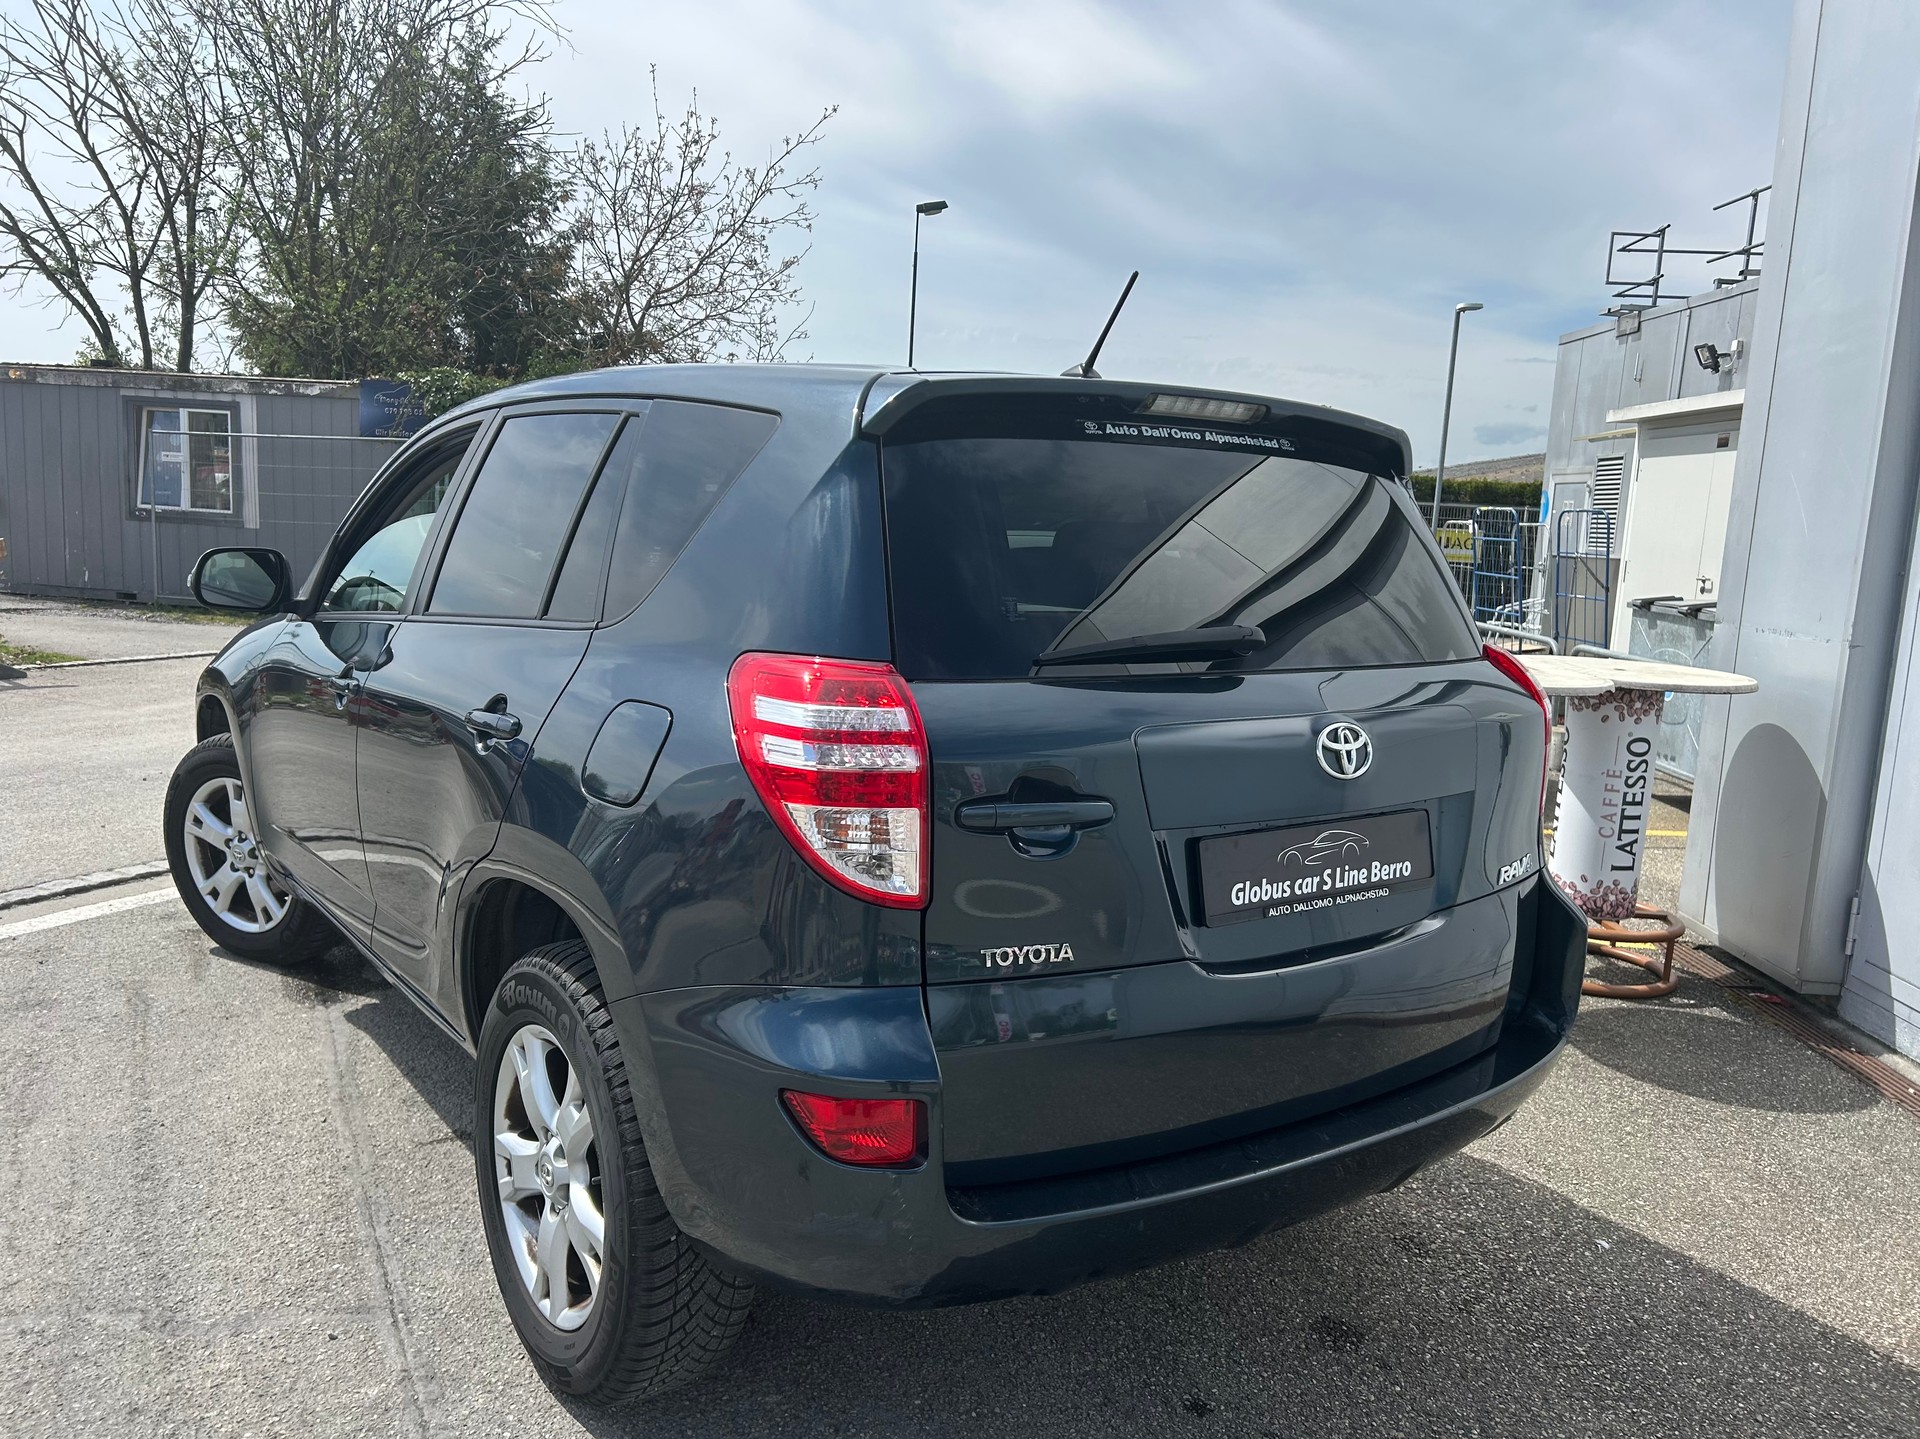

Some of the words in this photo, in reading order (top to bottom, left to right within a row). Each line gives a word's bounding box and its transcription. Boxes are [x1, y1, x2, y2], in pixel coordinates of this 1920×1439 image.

[1105, 423, 1139, 436] Auto
[1141, 425, 1201, 441] Dall'Omo
[1204, 431, 1280, 449] Alpnachstad
[1598, 768, 1623, 839] CAFFÈ
[1610, 736, 1651, 873] LATTESSO
[1231, 877, 1291, 906] Globus
[1294, 875, 1321, 896] car
[1322, 868, 1333, 891] S
[1335, 864, 1368, 889] Line
[1370, 860, 1412, 883] Berro
[1268, 904, 1291, 917] AUTO
[1293, 897, 1333, 913] DALL'OMO
[1335, 887, 1390, 905] ALPNACHSTAD
[980, 943, 1075, 968] TOYOTA
[501, 979, 558, 1027] Barum
